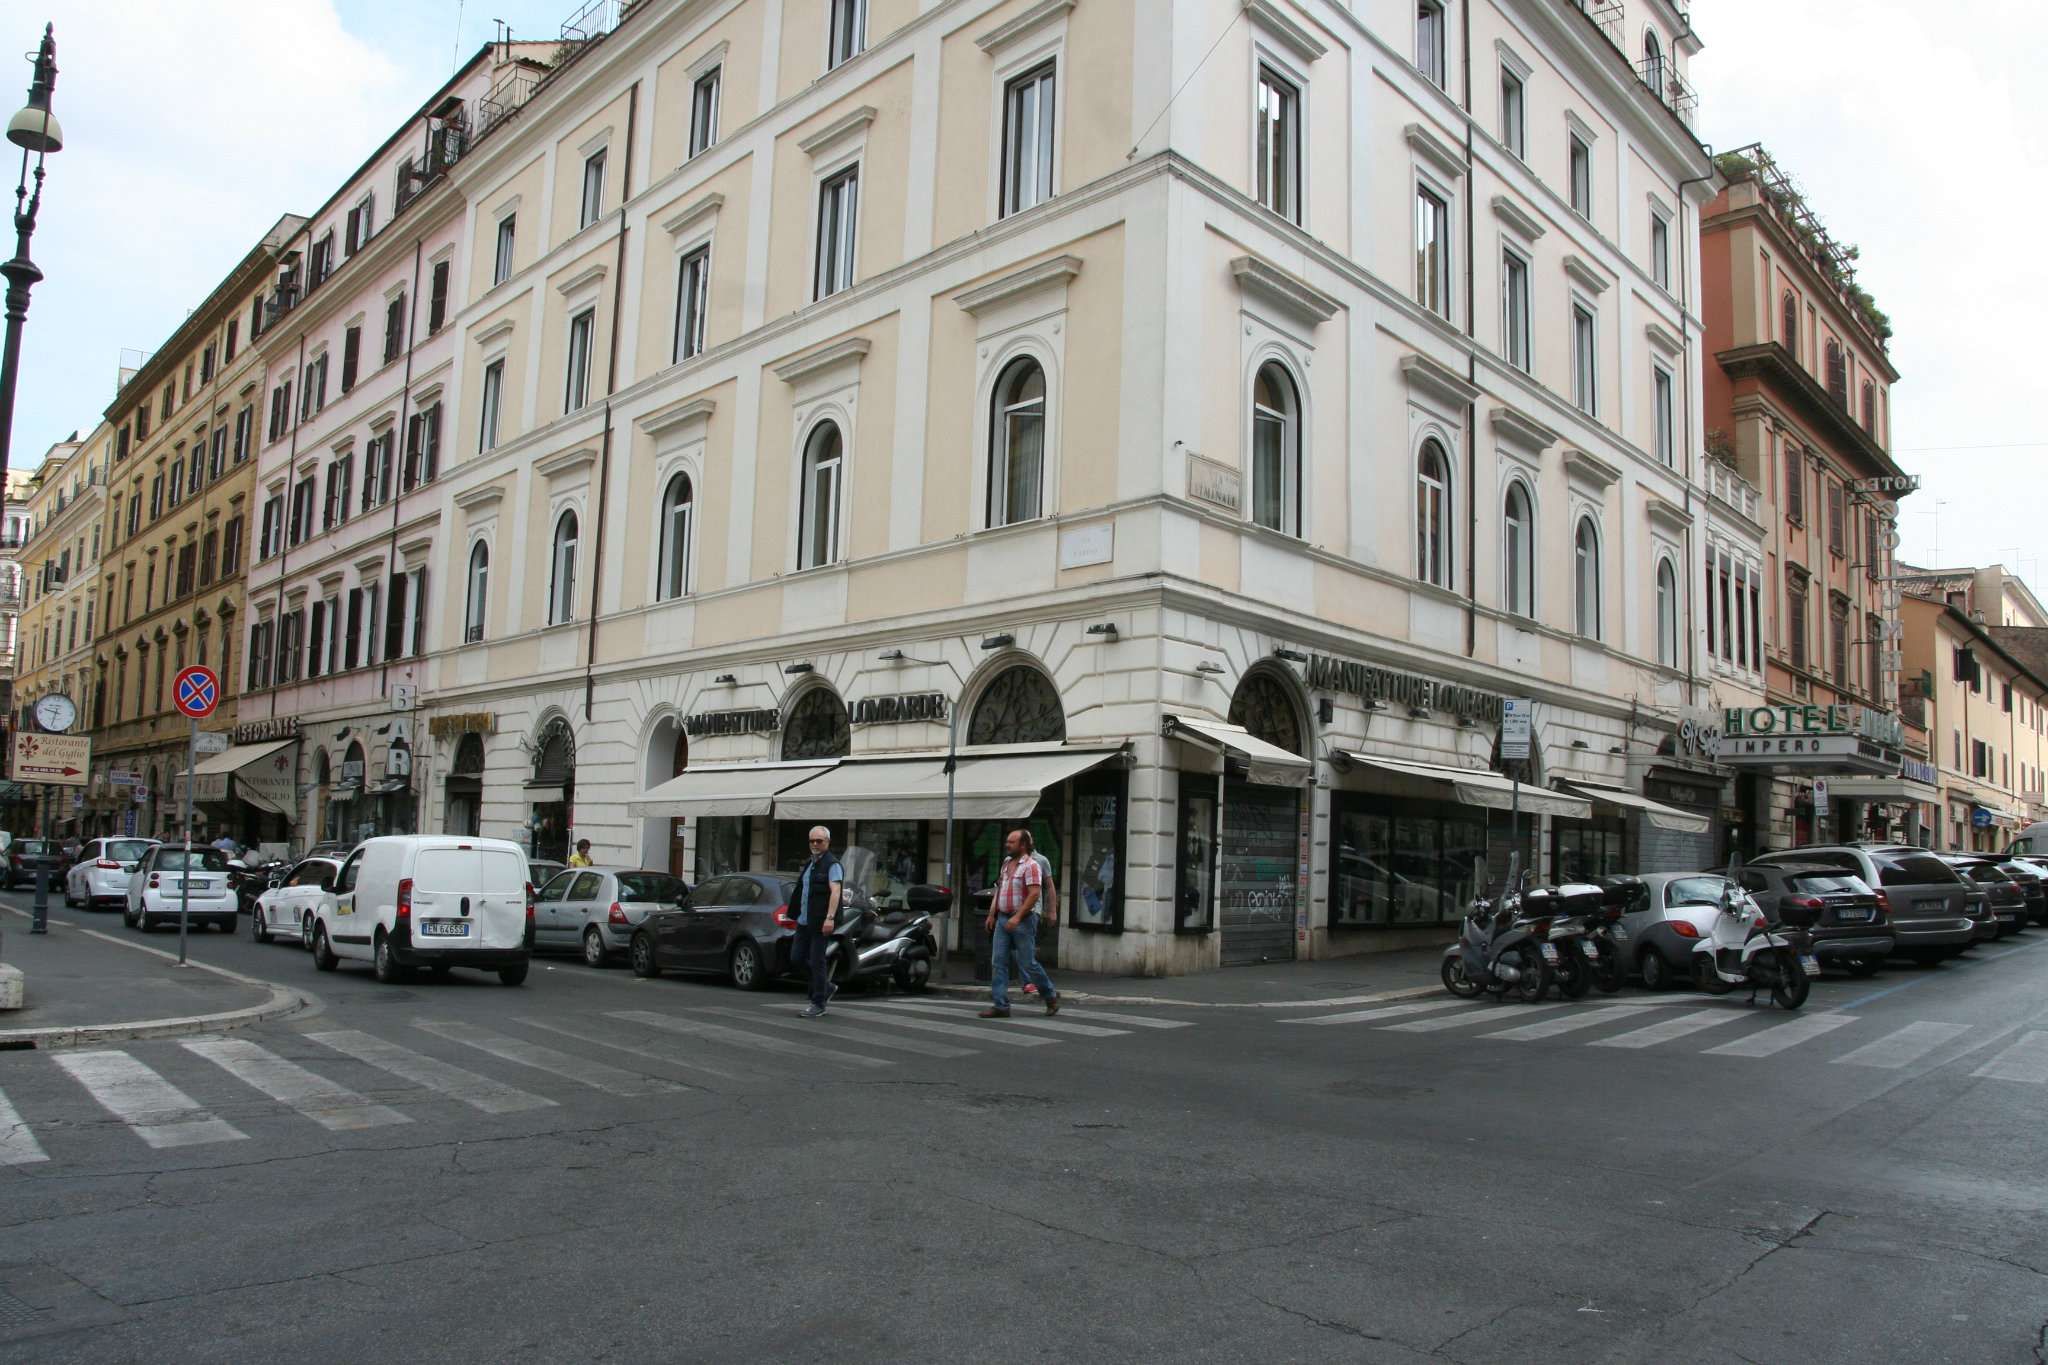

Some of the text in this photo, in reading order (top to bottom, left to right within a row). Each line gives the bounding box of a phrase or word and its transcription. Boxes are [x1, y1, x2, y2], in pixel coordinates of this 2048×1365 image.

[1308, 653, 1432, 708] MANIFATTURE
[848, 693, 948, 724] LOMBARDE
[1433, 682, 1504, 725] LOMBARD
[1725, 704, 1847, 734] HOTEL
[1734, 738, 1821, 753] IMPERO
